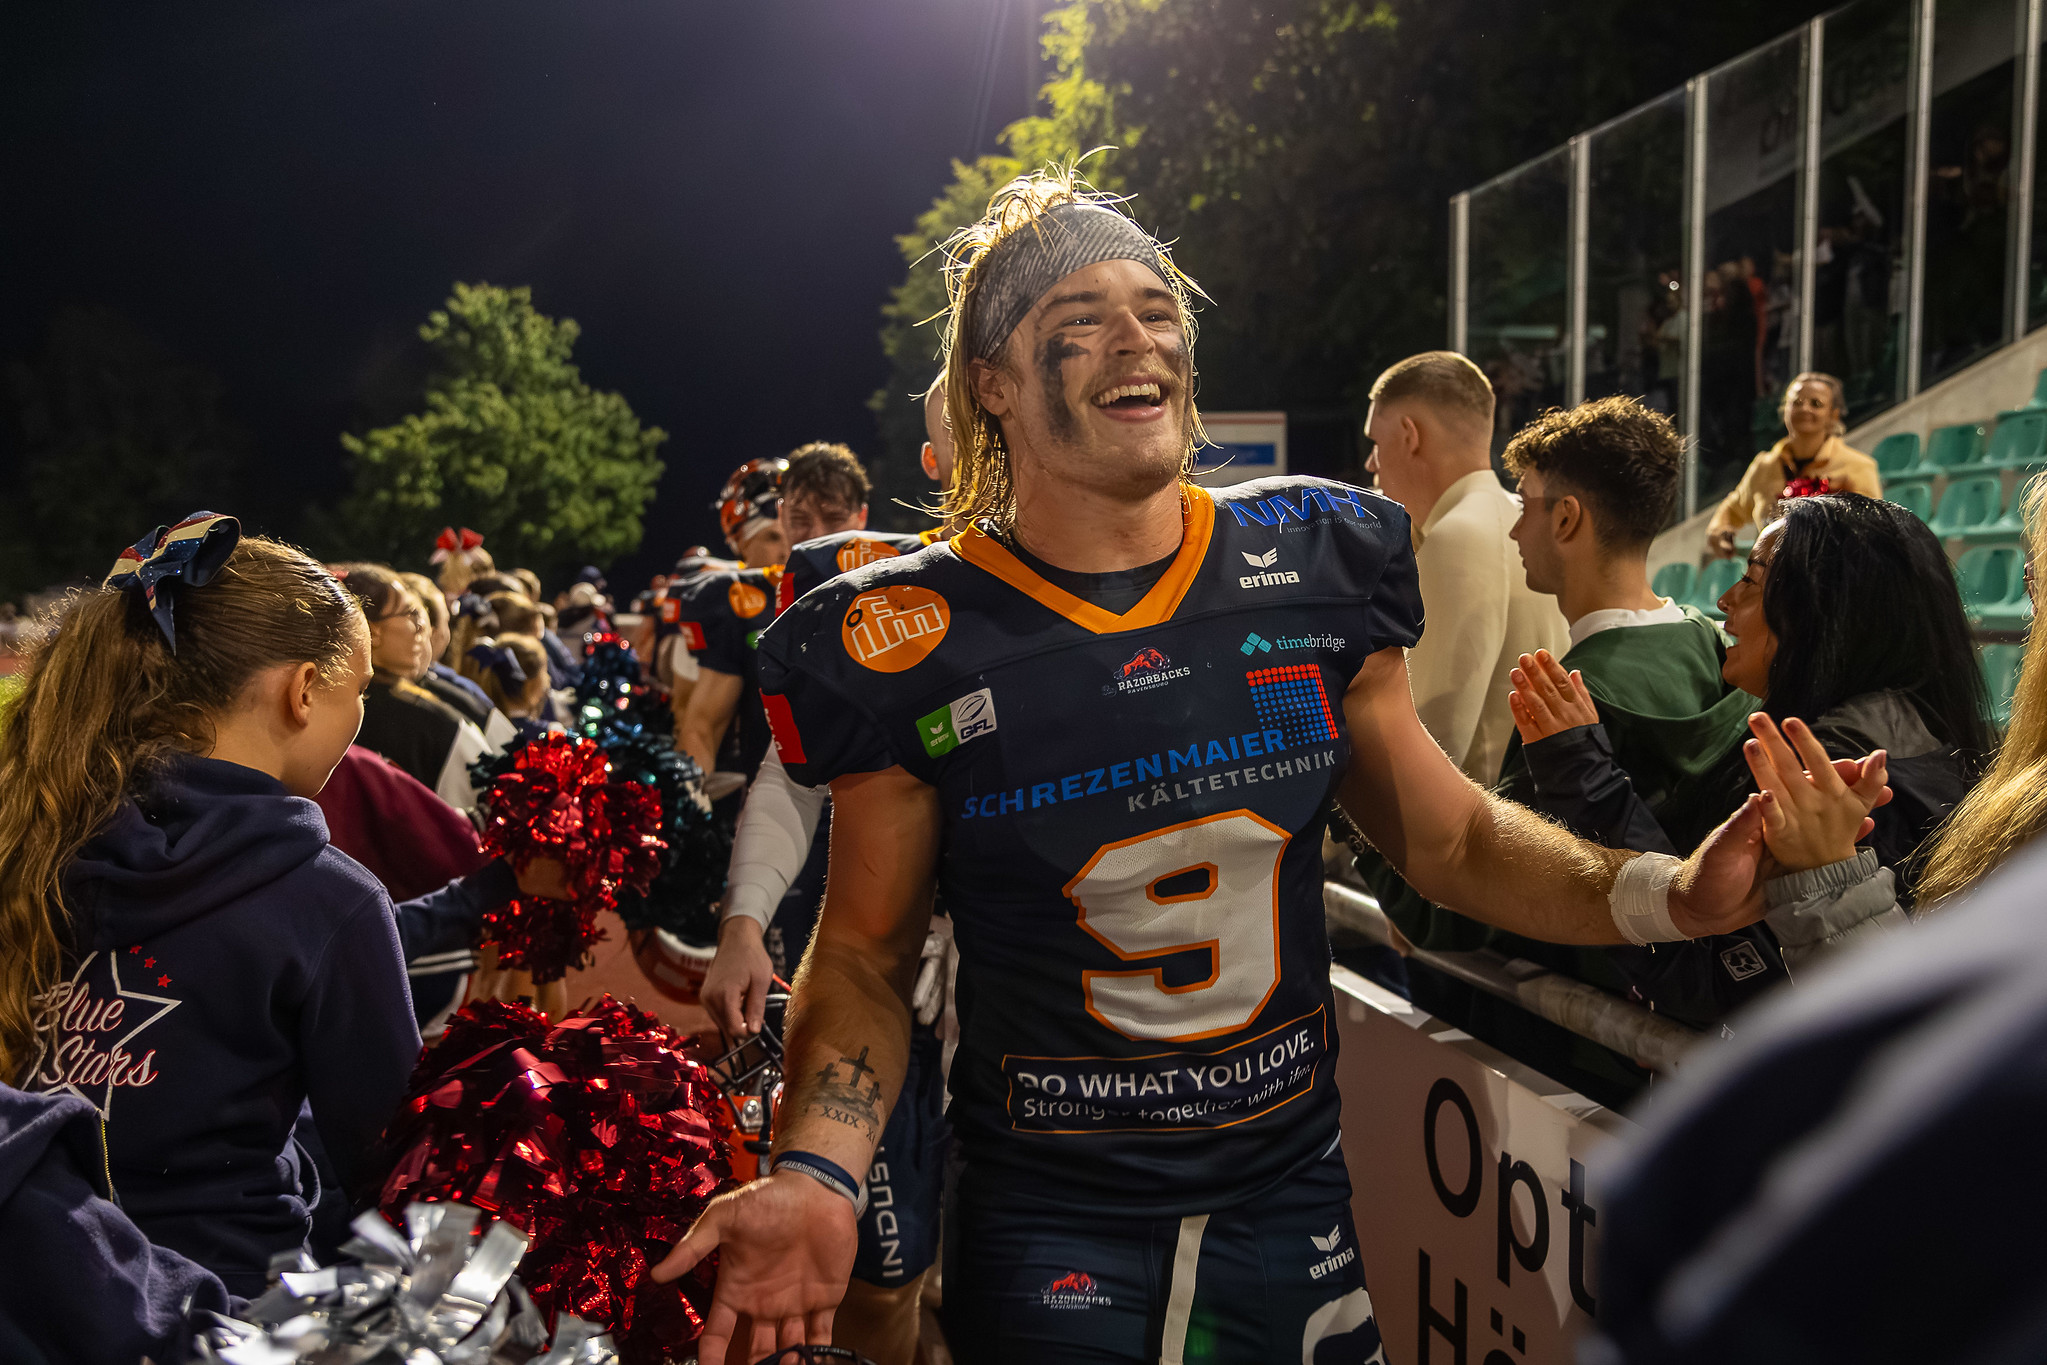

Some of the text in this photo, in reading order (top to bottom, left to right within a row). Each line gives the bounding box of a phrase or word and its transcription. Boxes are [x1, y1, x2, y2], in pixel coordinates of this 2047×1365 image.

[1239, 570, 1300, 589] erima
[1276, 633, 1346, 652] timebridge
[1117, 666, 1191, 691] RAZORBACKS
[960, 721, 993, 740] GFL
[961, 729, 1287, 819] SCHREZENMAIER
[1127, 750, 1336, 812] KÄLTETECHNIK
[1062, 808, 1293, 1042] 9
[40, 1034, 159, 1087] Stars
[1078, 1069, 1179, 1098] WHAT
[1187, 1057, 1252, 1092] YOU
[1258, 1028, 1315, 1076] LOVE.
[1248, 1077, 1285, 1107] with
[1309, 1247, 1355, 1280] erima
